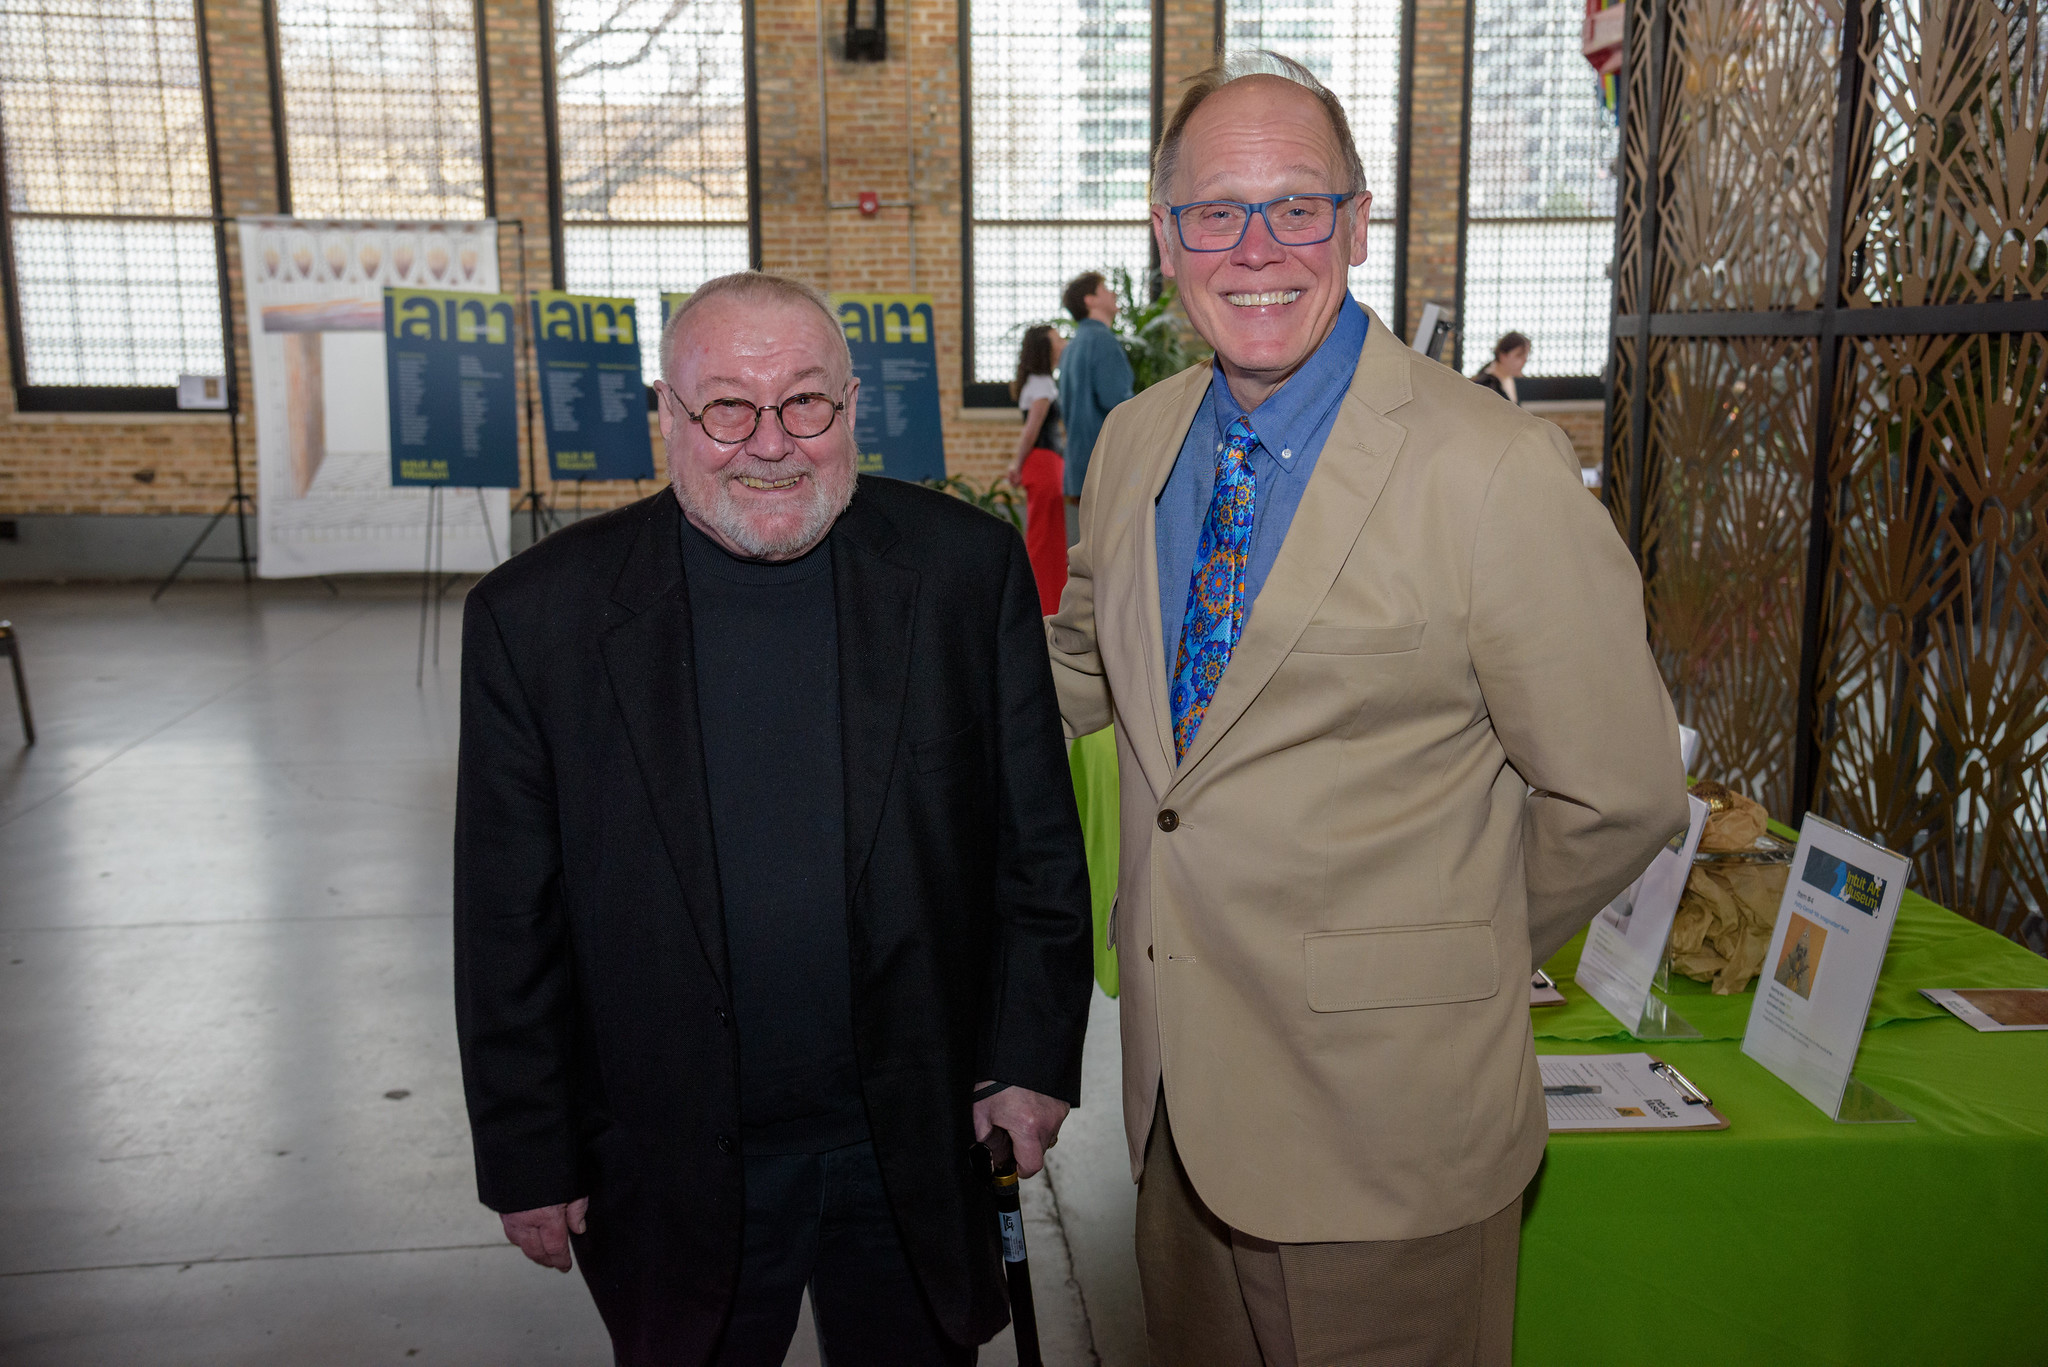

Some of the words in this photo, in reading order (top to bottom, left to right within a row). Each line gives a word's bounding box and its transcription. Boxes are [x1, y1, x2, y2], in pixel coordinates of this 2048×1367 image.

[1845, 883, 1878, 909] Museum
[1846, 871, 1867, 891] Intuit
[1867, 881, 1881, 898] Art
